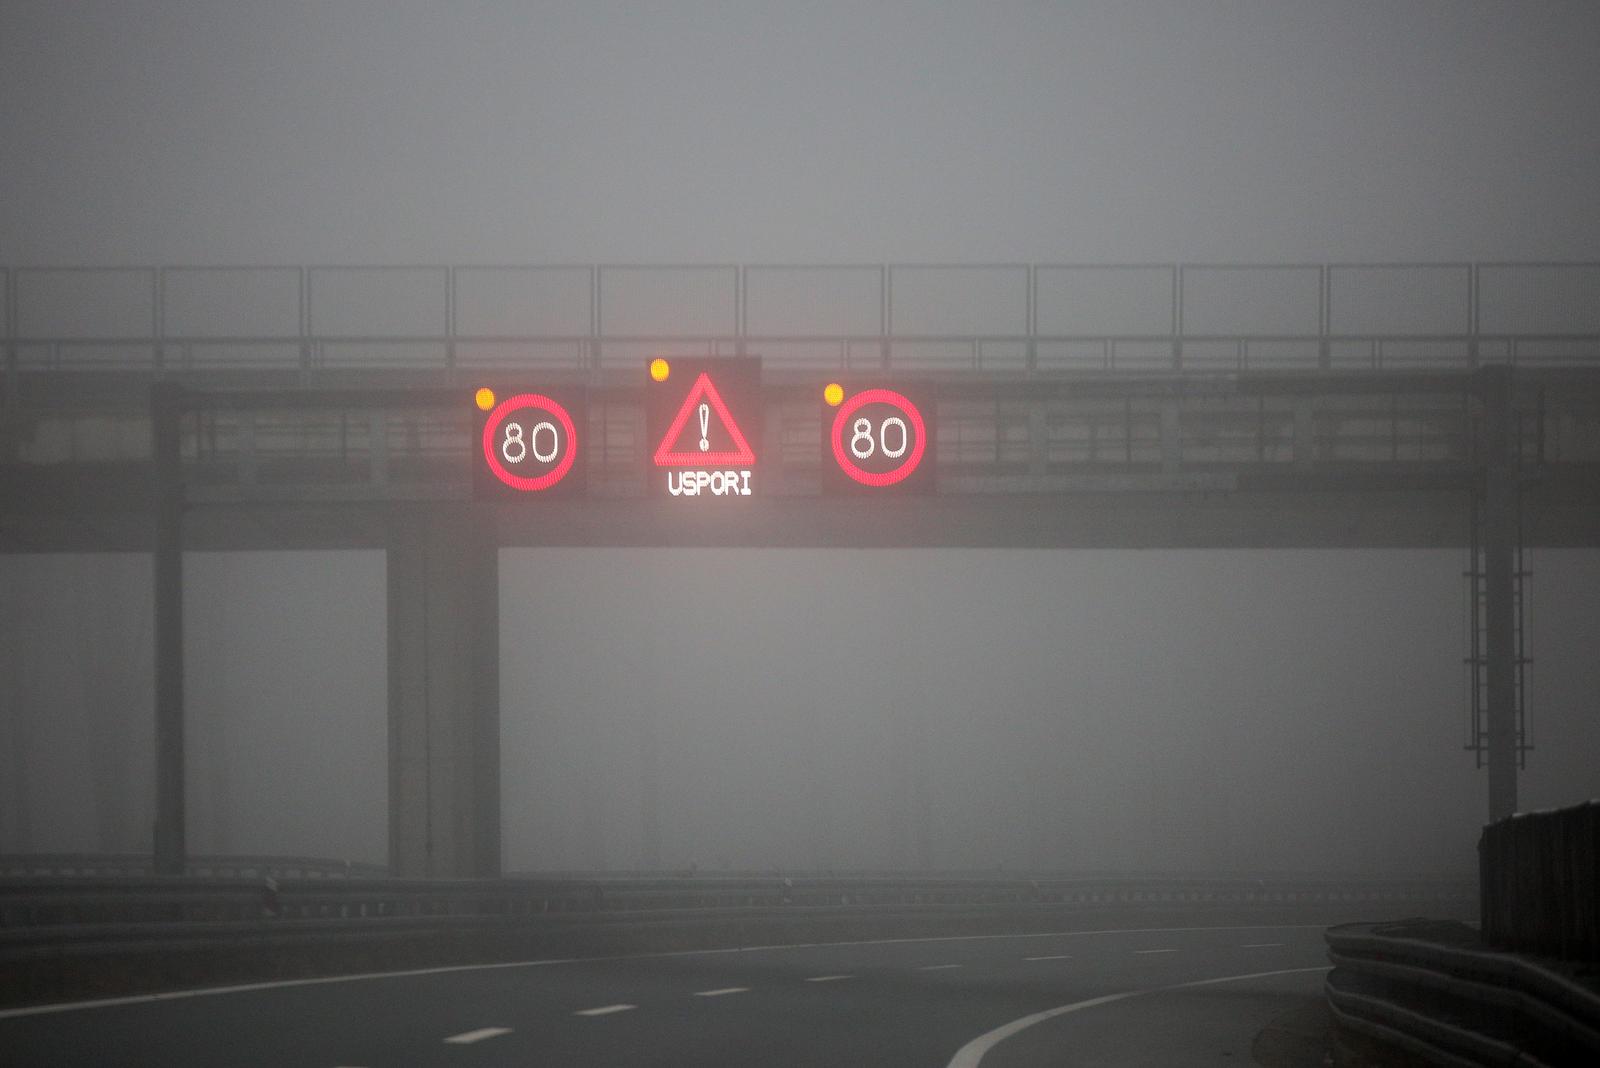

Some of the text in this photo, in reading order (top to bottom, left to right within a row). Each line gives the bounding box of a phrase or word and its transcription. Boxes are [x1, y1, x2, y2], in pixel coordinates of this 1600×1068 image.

[502, 421, 559, 464] 80
[851, 417, 907, 460] 80
[667, 470, 752, 497] USPORI
